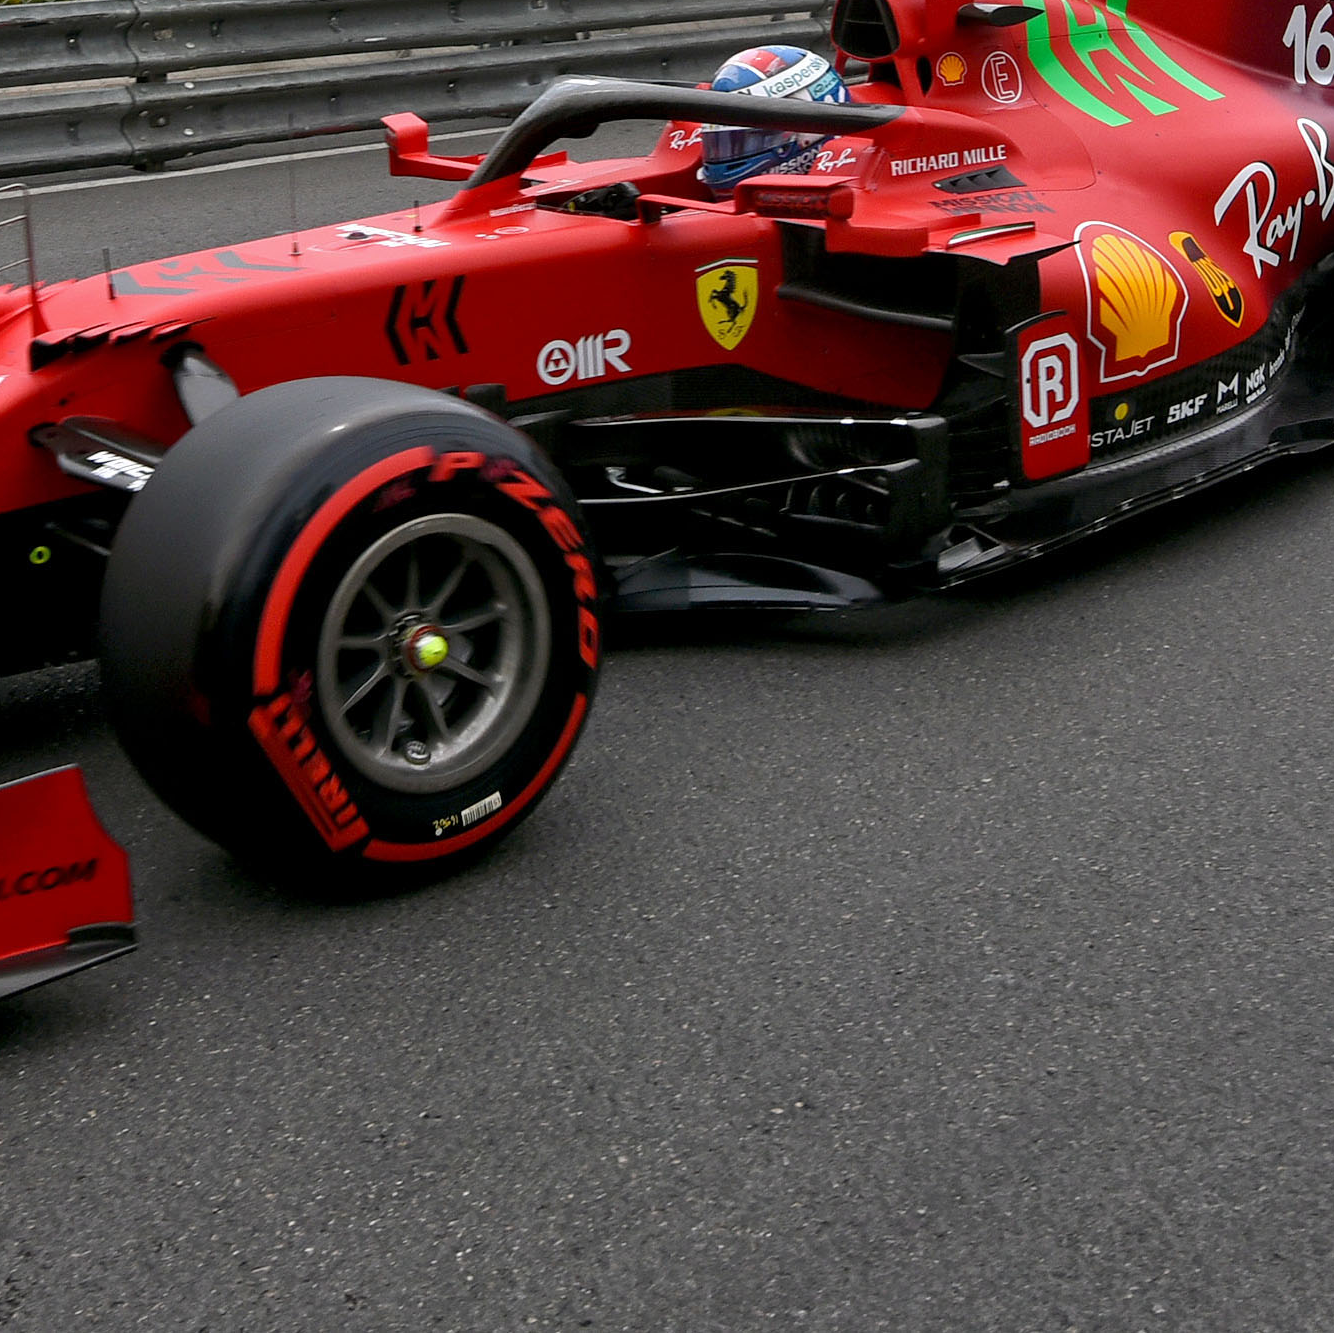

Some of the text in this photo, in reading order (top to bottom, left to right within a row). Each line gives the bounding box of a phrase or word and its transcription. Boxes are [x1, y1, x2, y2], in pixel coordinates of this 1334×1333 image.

[891, 144, 1007, 177] RICHARD MILLE
[1245, 363, 1266, 395] NGK
[1166, 394, 1208, 424] SKF
[496, 469, 600, 669] ZERO
